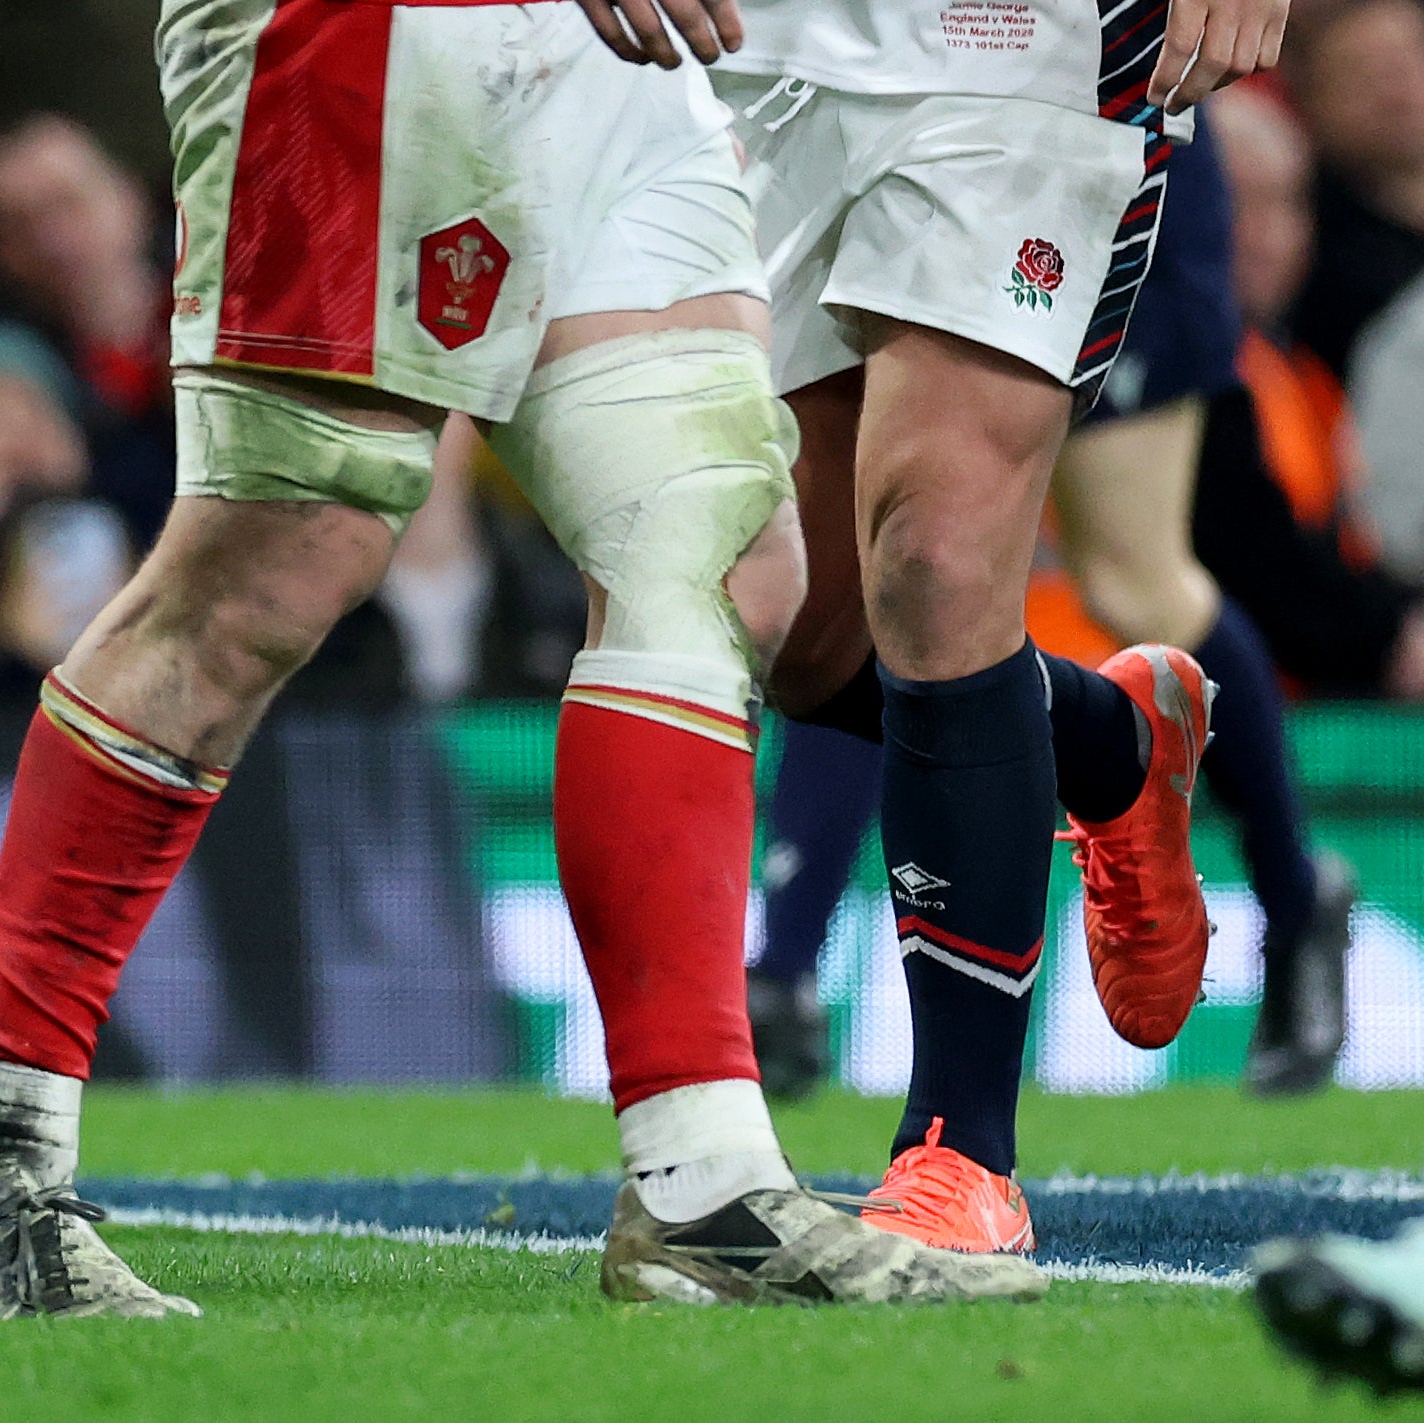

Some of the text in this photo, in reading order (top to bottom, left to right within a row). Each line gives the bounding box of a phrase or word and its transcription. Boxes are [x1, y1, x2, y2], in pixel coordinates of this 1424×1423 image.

[987, 1, 1029, 14] George
[940, 11, 1036, 26] England v Wales
[941, 25, 966, 36] 15th
[969, 26, 1005, 37] March
[946, 38, 1029, 52] 1373 101st Cap
[895, 889, 946, 911] umbro
